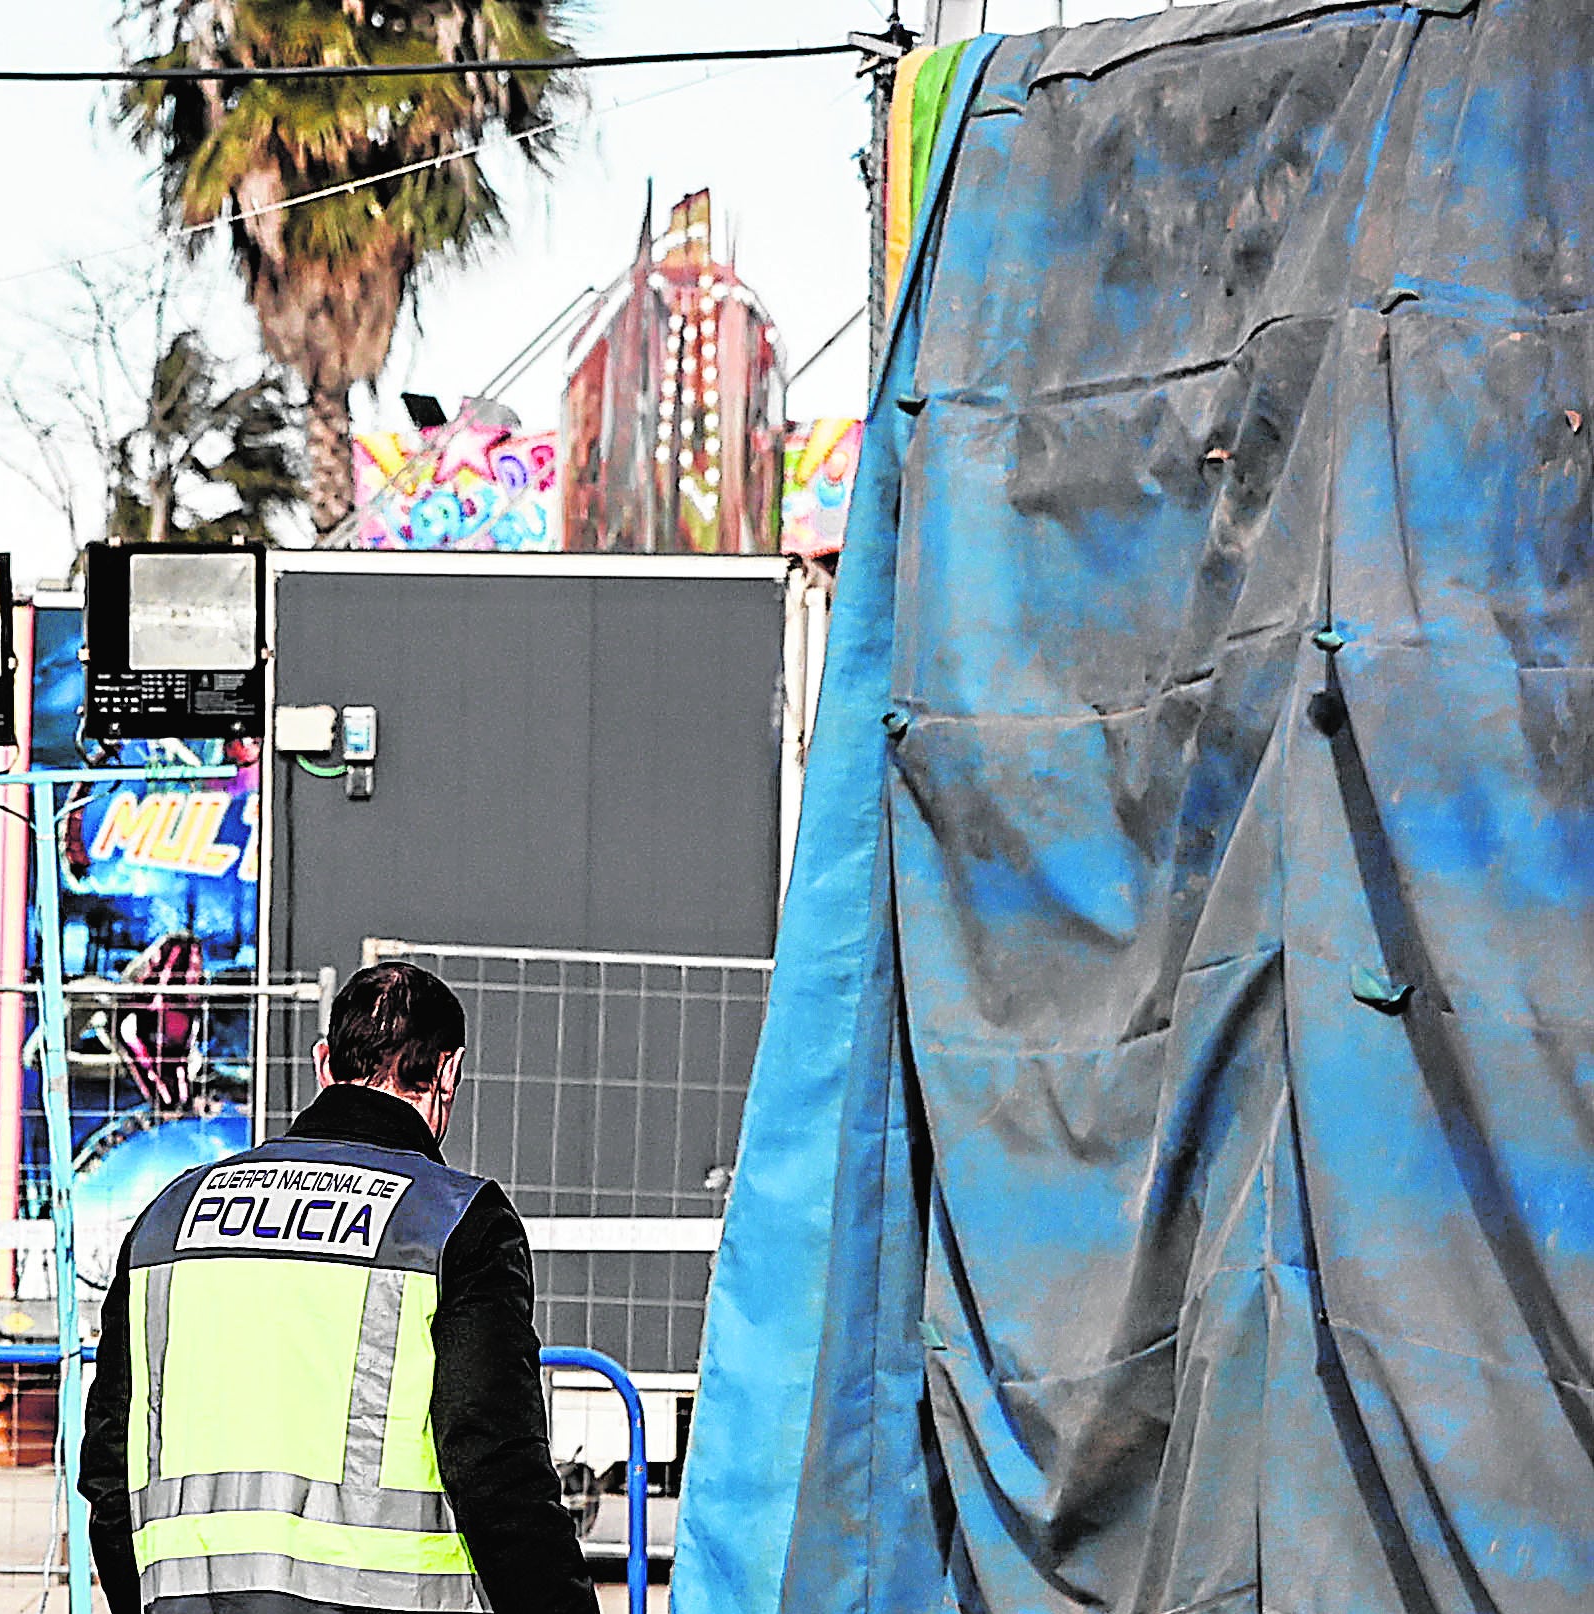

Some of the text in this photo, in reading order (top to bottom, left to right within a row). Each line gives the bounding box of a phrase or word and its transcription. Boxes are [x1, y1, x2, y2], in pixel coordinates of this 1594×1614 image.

[207, 1168, 398, 1198] CUERPO NACIONAL DE
[187, 1197, 373, 1247] POLICIA
